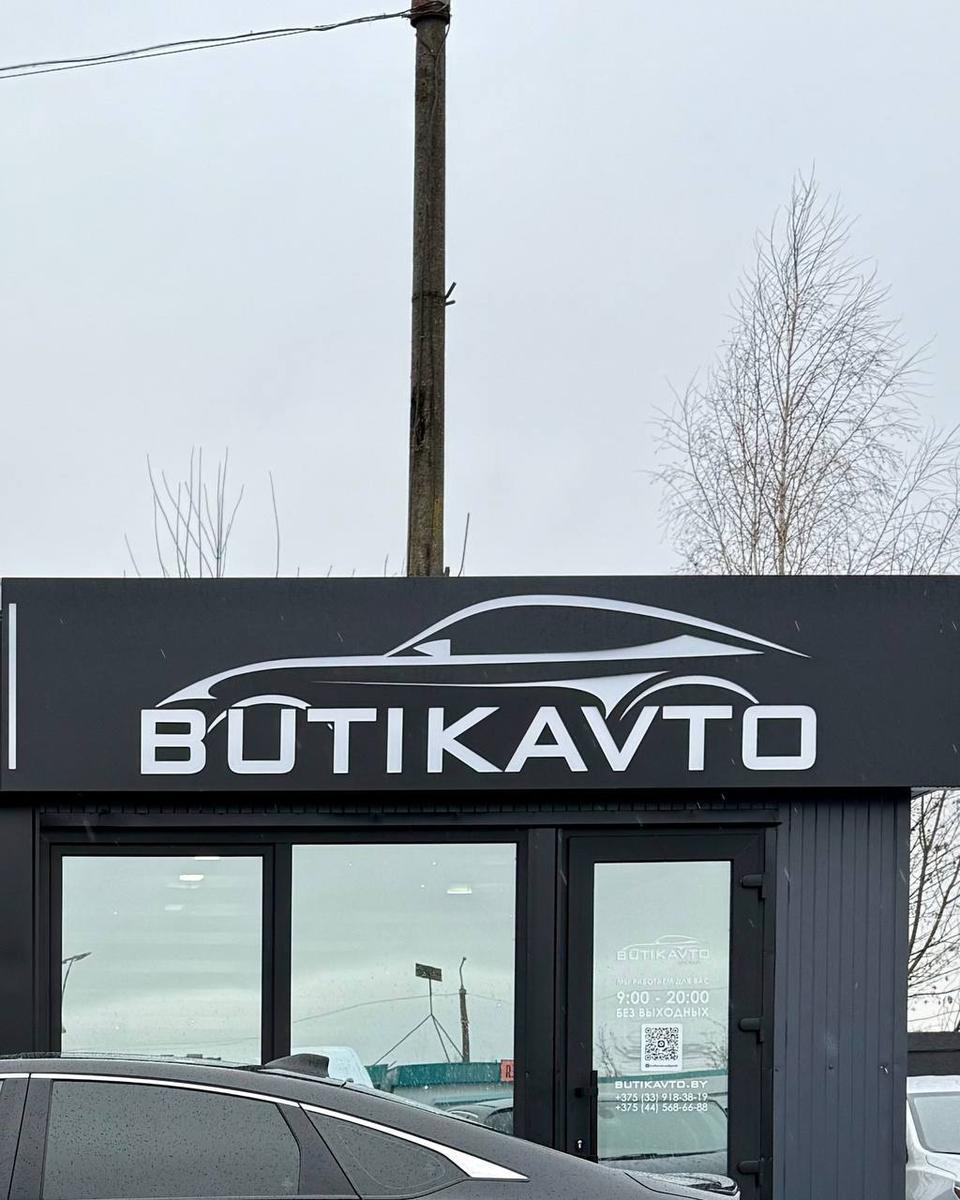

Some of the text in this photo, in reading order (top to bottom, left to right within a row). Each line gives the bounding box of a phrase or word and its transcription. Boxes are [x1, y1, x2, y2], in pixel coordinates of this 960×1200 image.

[140, 704, 817, 775] BUTIKAVTO
[617, 949, 710, 961] BUTIKAVTO
[617, 990, 649, 1005] 9:00
[666, 990, 710, 1004] 20:00
[616, 1007, 709, 1018] БЕЗ ВЫХОДНЫХ
[614, 1080, 709, 1089] BUTIKAVTO.BY
[615, 1093, 709, 1104] +375 (33) 918-38-19
[615, 1103, 709, 1114] +375 (44) 568-66-88
